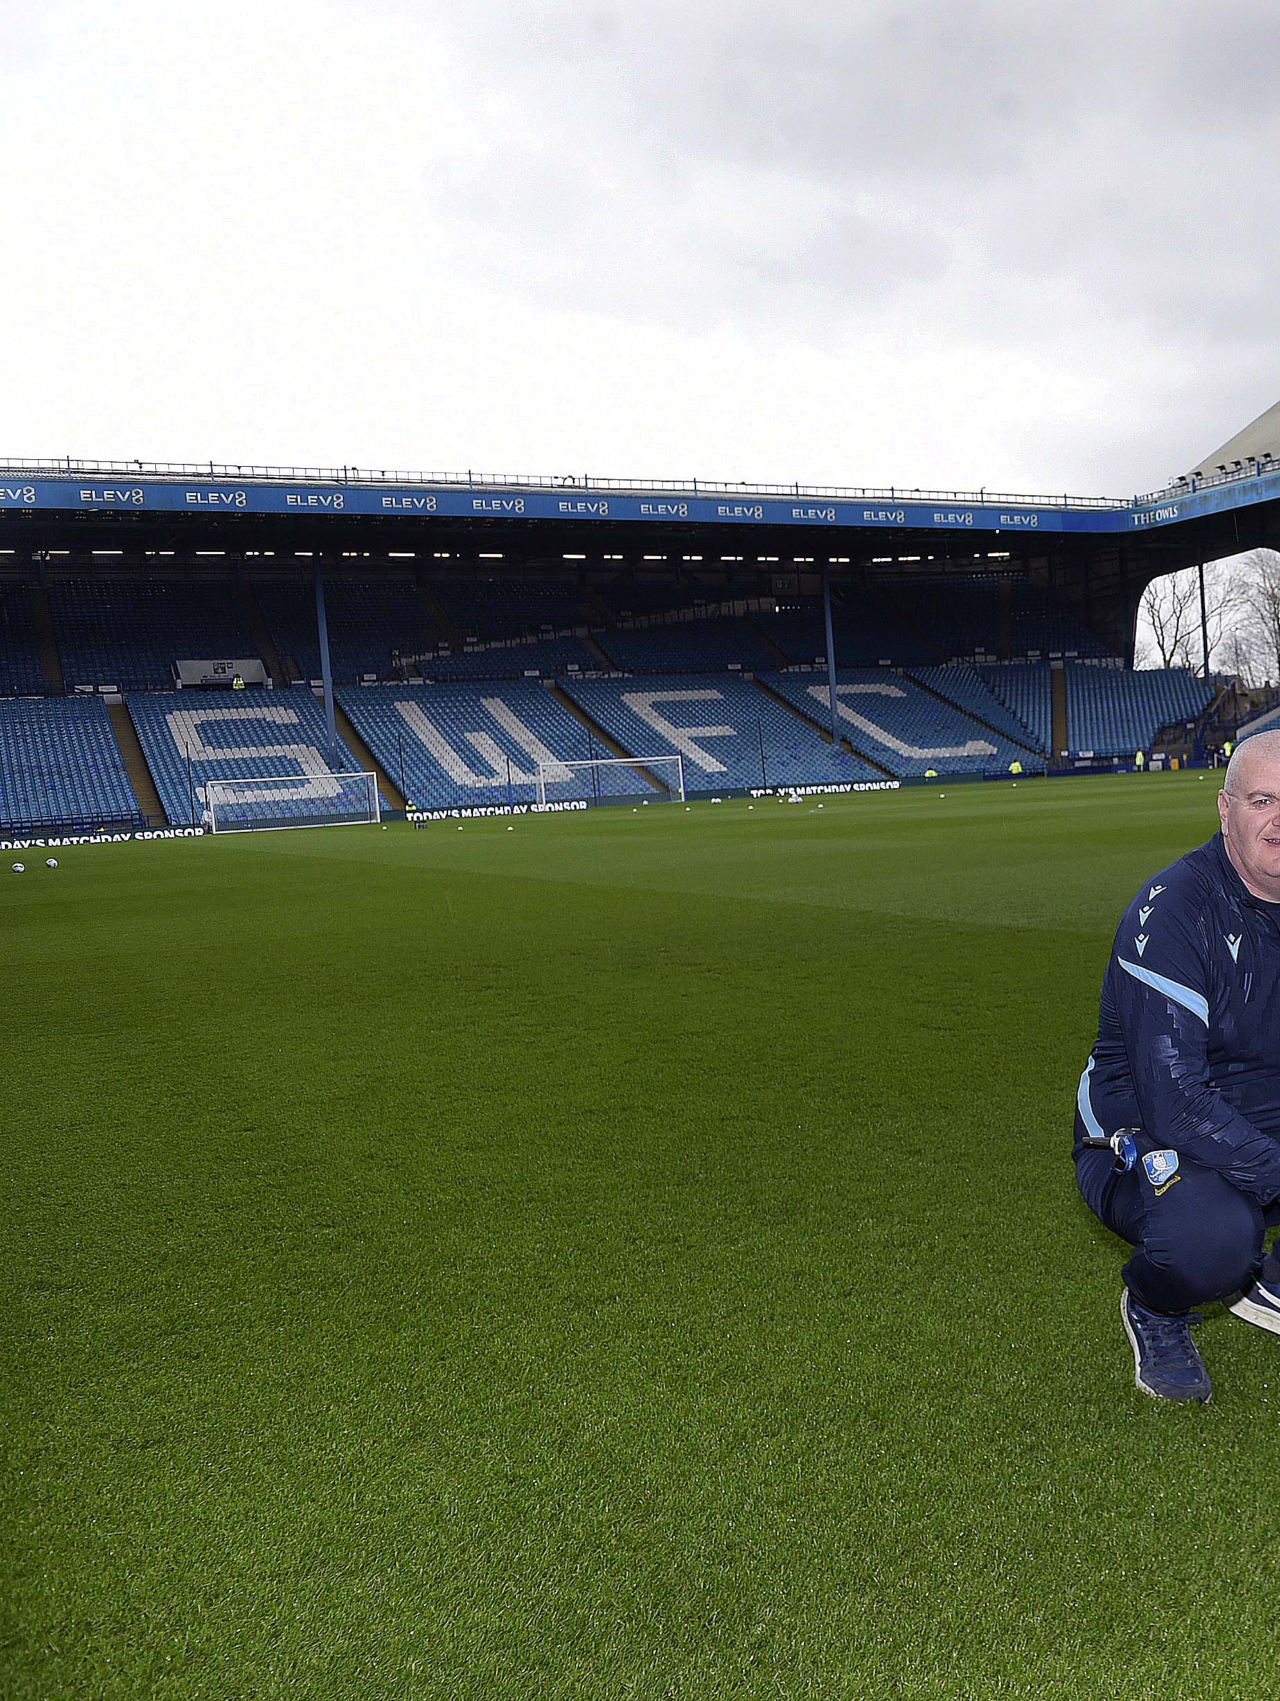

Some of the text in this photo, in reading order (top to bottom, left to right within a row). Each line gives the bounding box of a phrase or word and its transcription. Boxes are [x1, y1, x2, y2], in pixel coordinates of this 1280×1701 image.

[80, 488, 144, 505] ELEV8
[186, 490, 247, 507] ELEV8
[286, 493, 344, 510] ELEV8
[382, 495, 437, 512] ELEV8
[472, 498, 525, 514] ELEV8
[559, 501, 609, 516] ELEV8
[640, 503, 688, 518] ELEV8
[718, 505, 763, 520] ELEV8
[792, 507, 835, 522] ELEV8
[863, 510, 905, 524] ELEV8
[933, 512, 973, 525] ELEV8
[1000, 513, 1038, 528] ELEV8
[1132, 505, 1178, 525] THE OWLS
[0, 839, 46, 850] DAY'S
